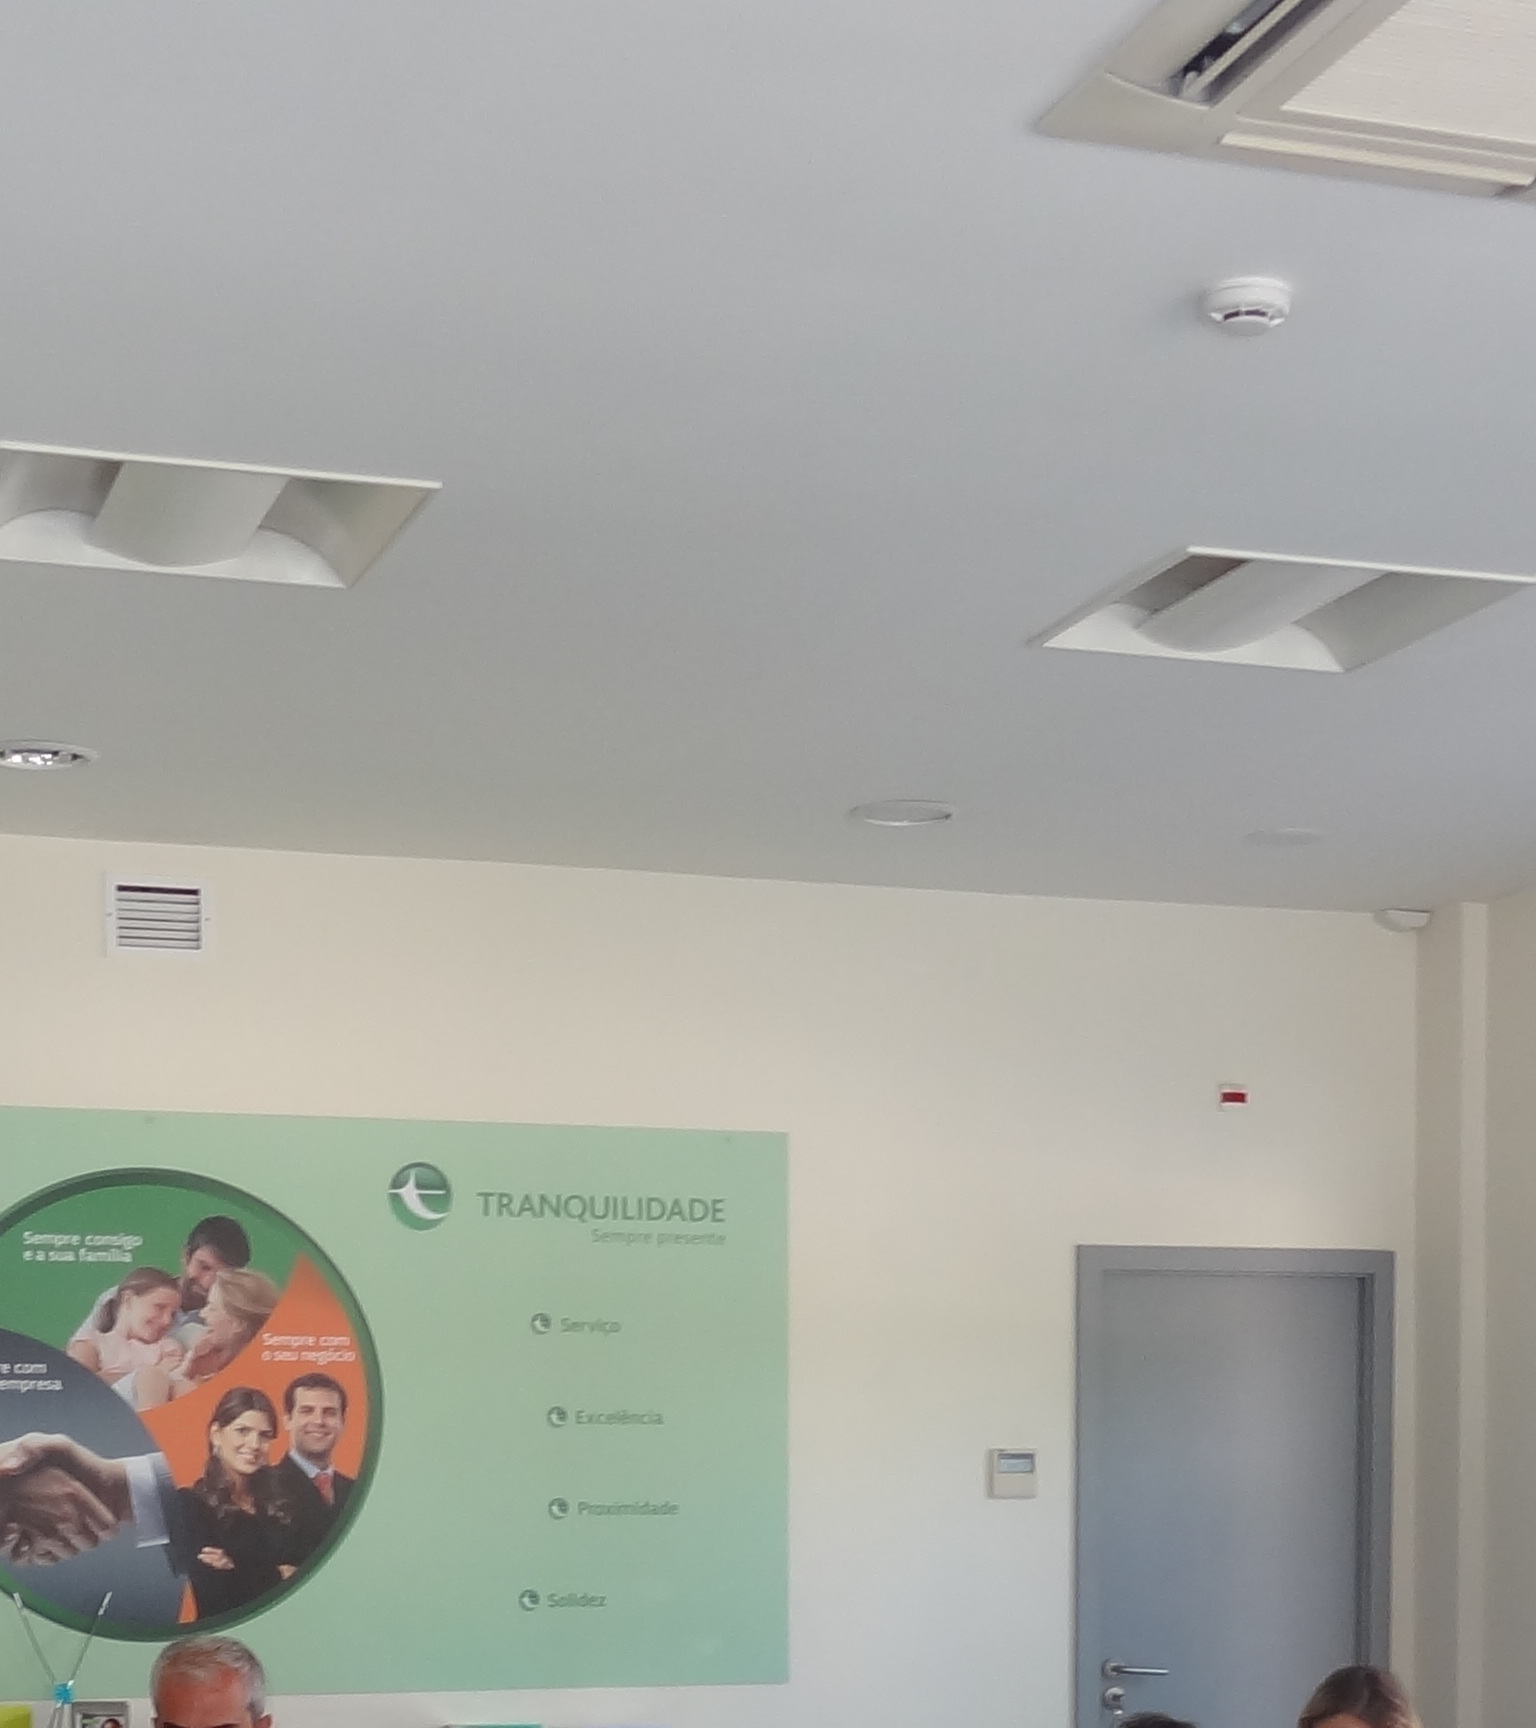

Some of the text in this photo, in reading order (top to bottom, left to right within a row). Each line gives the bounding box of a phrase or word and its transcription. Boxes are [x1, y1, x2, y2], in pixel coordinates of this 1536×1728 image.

[476, 1191, 727, 1224] TRANQUILIDADE
[22, 1231, 144, 1250] Sempre consigo
[590, 1229, 653, 1247] Sempre
[22, 1250, 34, 1261] e
[35, 1250, 46, 1261] a
[48, 1250, 76, 1262] sua
[560, 1317, 622, 1337] Serviço
[261, 1333, 351, 1349] Sempre com
[261, 1350, 272, 1361] o
[273, 1350, 299, 1361] seu
[13, 1363, 48, 1374] com
[574, 1409, 664, 1426] Excelência
[576, 1501, 680, 1517] Proximidade
